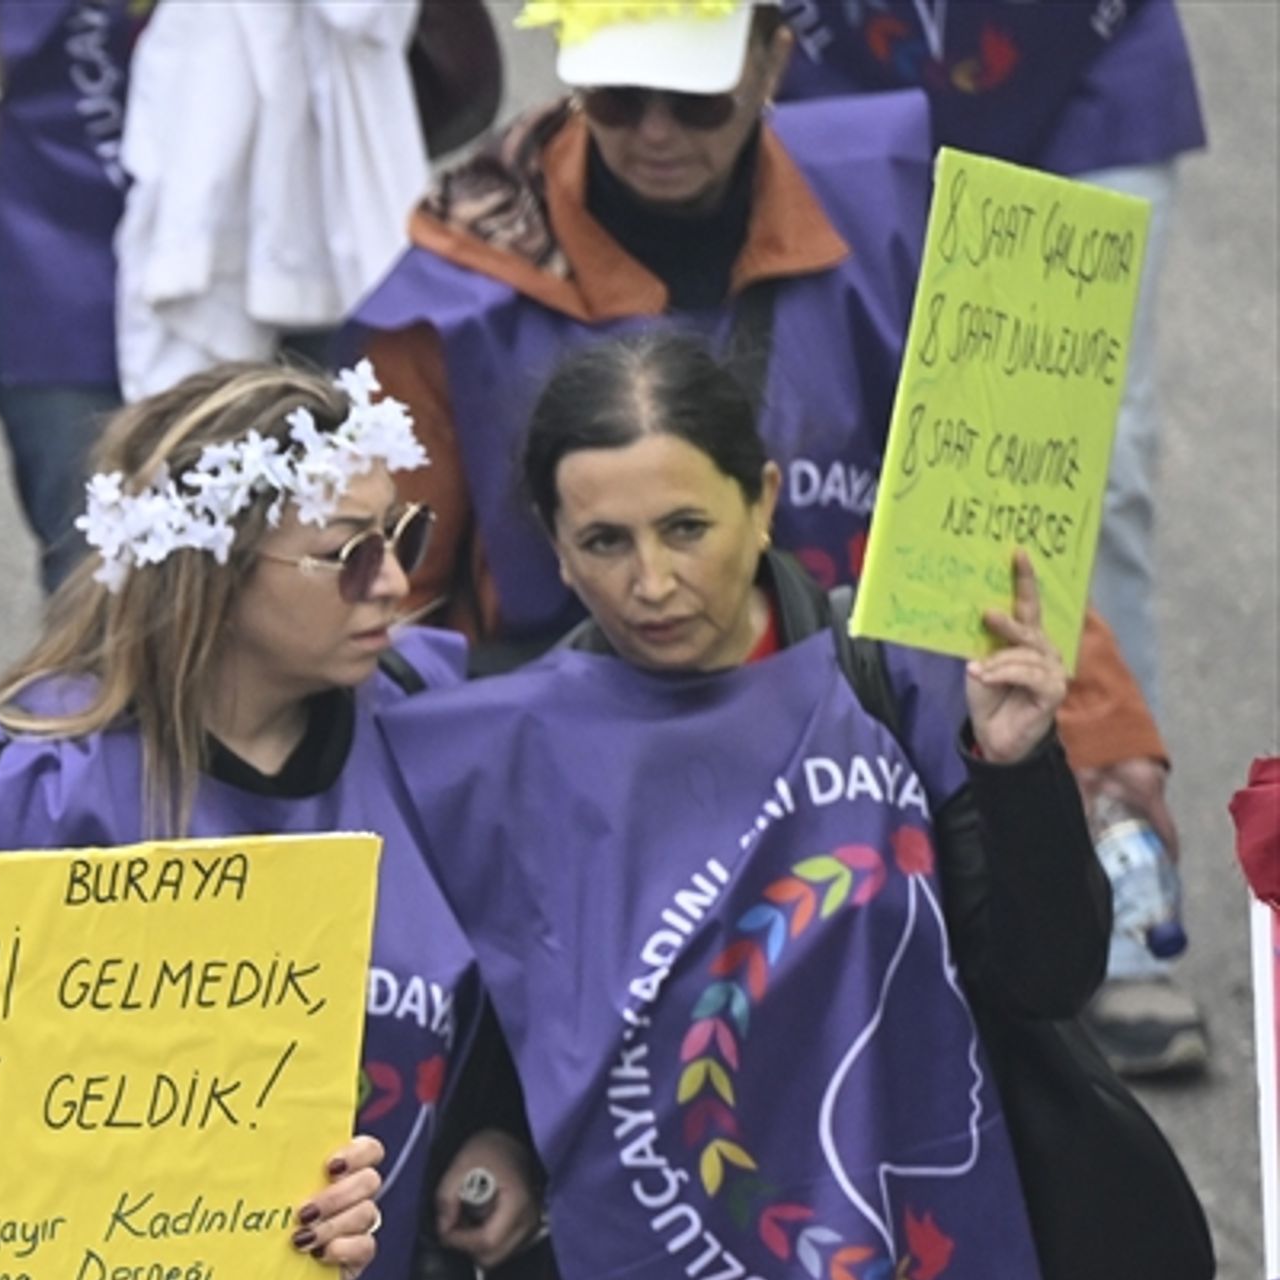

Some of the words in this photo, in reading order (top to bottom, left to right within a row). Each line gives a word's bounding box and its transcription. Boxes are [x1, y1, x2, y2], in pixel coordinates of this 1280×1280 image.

[941, 168, 967, 266] 8
[918, 293, 947, 367] 8
[900, 403, 928, 478] 8
[63, 853, 250, 906] BURAYA
[58, 951, 327, 1016] GELMEDİK,
[43, 1040, 298, 1131] GELDİK!
